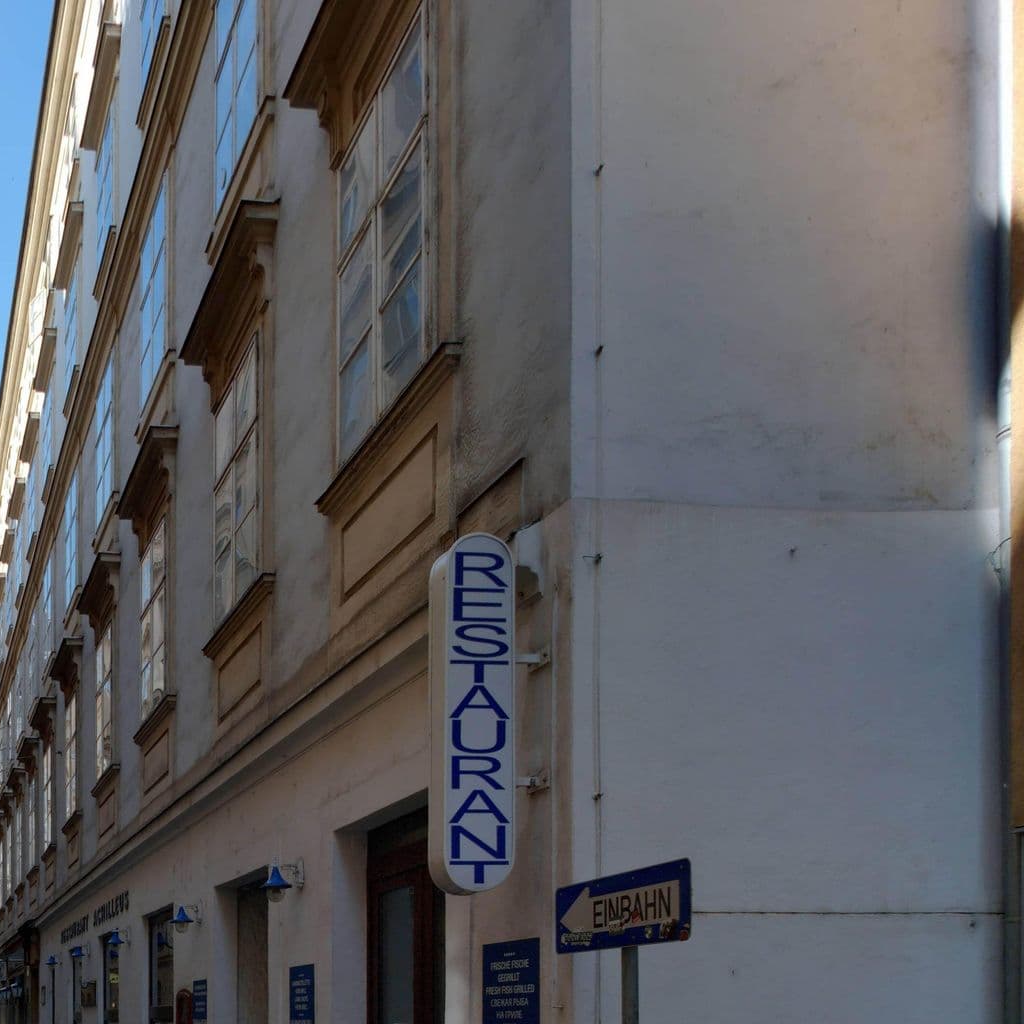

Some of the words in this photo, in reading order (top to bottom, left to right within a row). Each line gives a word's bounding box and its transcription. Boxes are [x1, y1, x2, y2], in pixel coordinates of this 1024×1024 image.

[449, 551, 510, 884] RESTAURANT
[593, 886, 671, 928] EINBAHN
[513, 984, 535, 993] GRILLED
